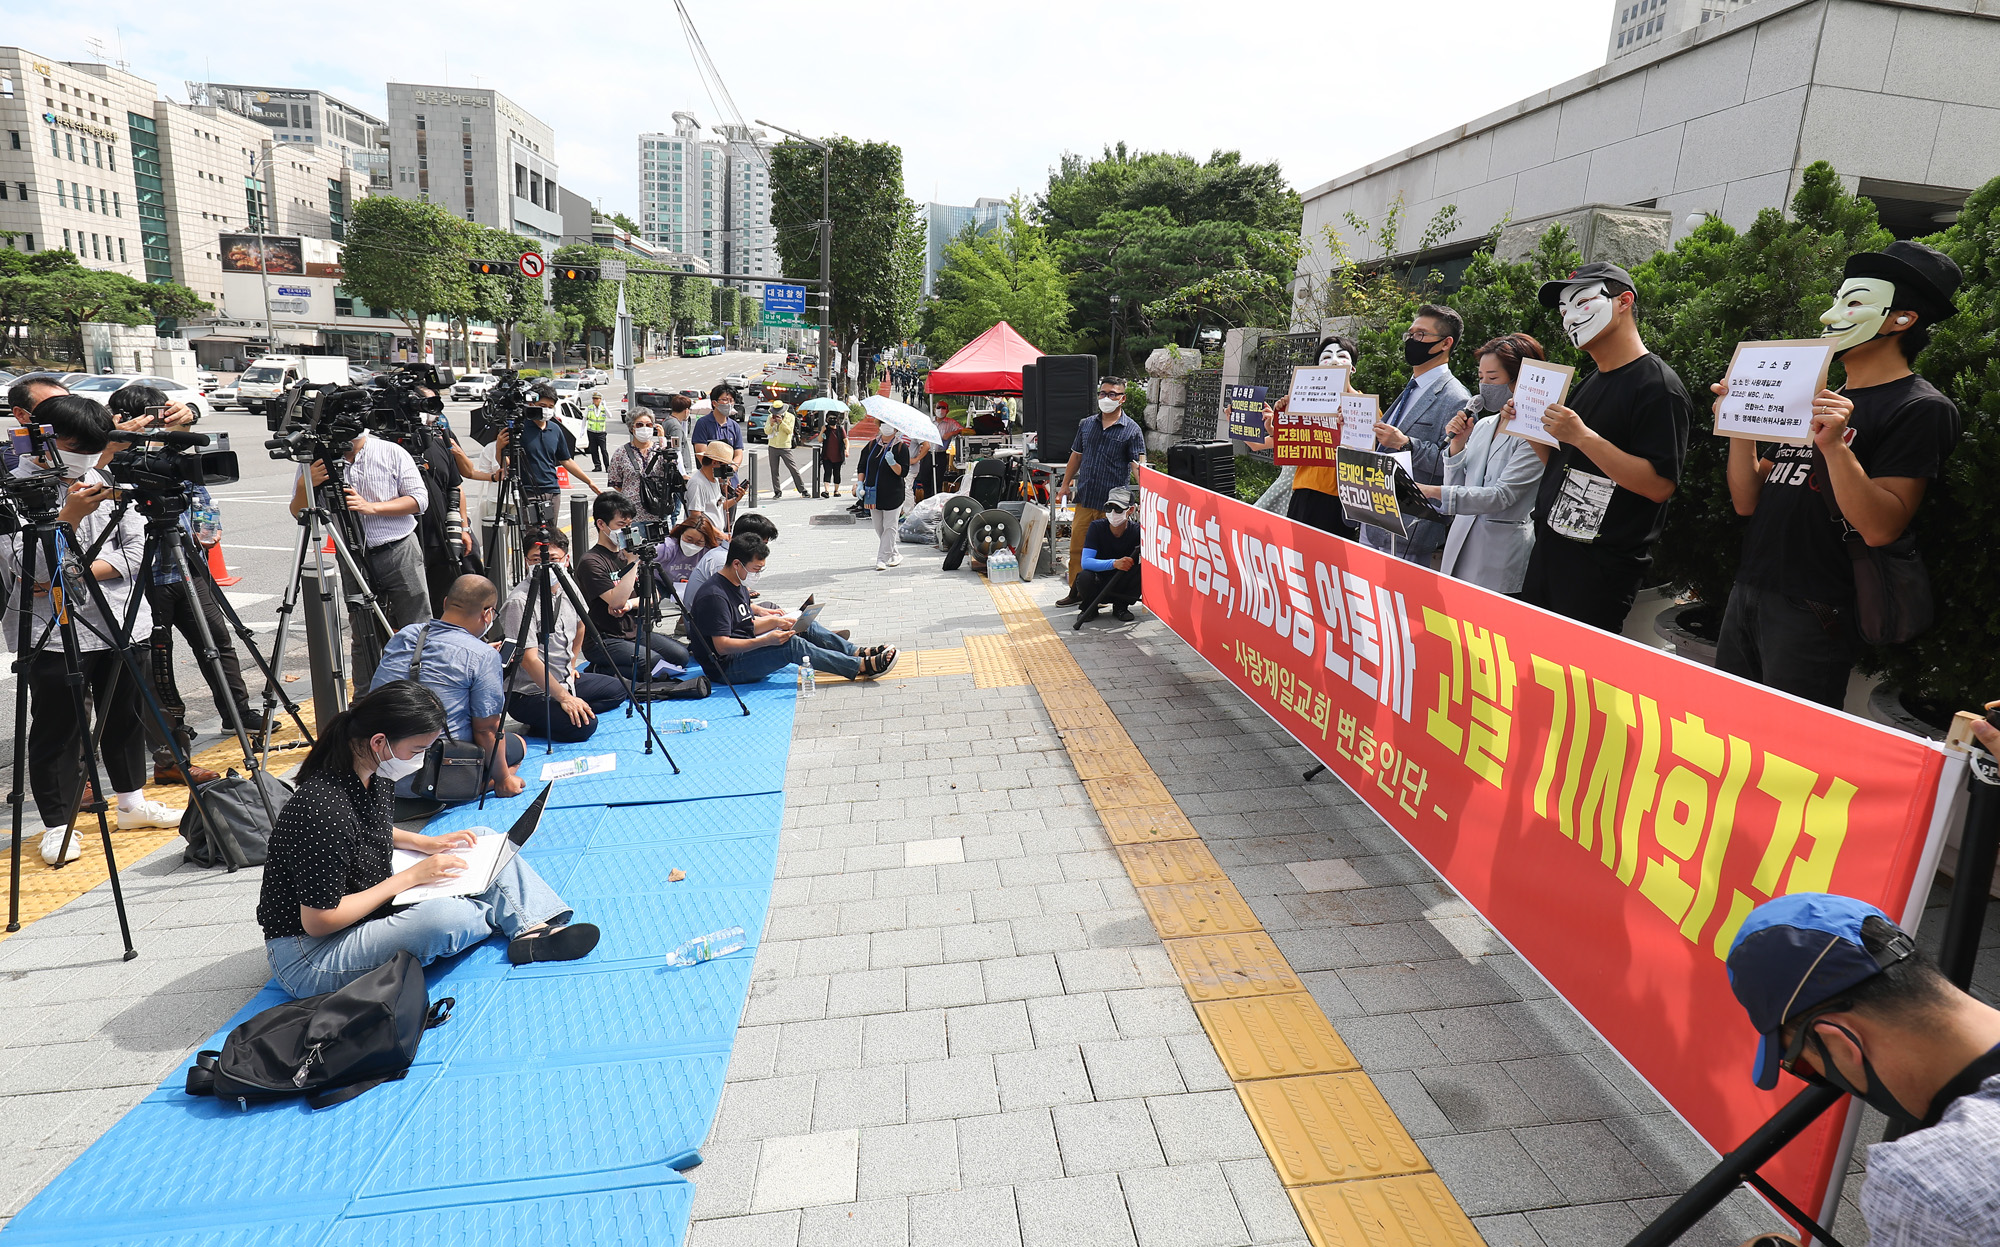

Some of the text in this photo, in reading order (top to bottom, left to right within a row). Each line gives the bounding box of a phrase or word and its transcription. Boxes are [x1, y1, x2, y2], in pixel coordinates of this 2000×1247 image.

[32, 61, 51, 77] ACE
[415, 89, 490, 109] 흰물결아트센터
[767, 288, 803, 299] 대검찰청
[1751, 379, 1782, 388] 사랑제일교회
[1744, 402, 1765, 411] 연합뉴스,
[1230, 411, 1246, 423] 광화문
[1742, 414, 1802, 427] 명예훼손(허위사실유포)
[1277, 428, 1311, 442] 교회에
[1313, 429, 1333, 444] 책임
[1277, 445, 1322, 459] 떠넘기지
[1339, 461, 1364, 486] 문재인
[1365, 466, 1393, 491] 구속이
[1340, 484, 1400, 518] 최고의 방역
[1231, 529, 1315, 657] MBC등
[1314, 560, 1417, 723] 언론사
[1421, 605, 1518, 790] 고발
[1234, 637, 1332, 741] 사랑제일교회
[1335, 708, 1429, 820] 변호인단
